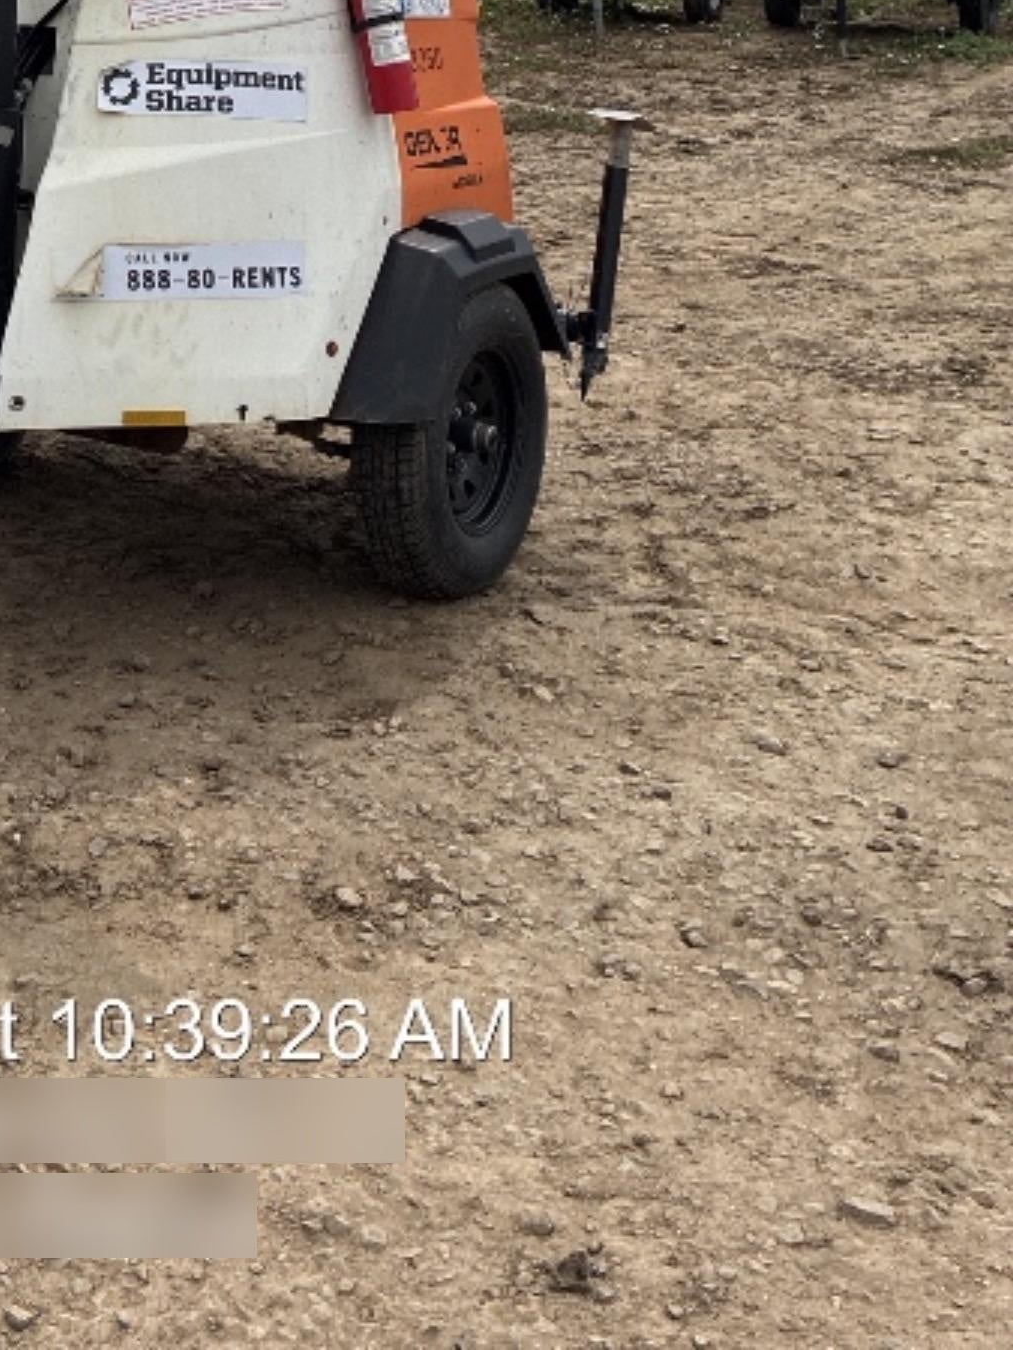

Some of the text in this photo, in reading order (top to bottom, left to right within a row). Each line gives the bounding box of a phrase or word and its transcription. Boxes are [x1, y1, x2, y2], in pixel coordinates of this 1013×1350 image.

[146, 62, 305, 92] Equipment
[146, 89, 234, 113] Share
[125, 252, 158, 265] CALL
[126, 265, 303, 292] 888-80-RENTS
